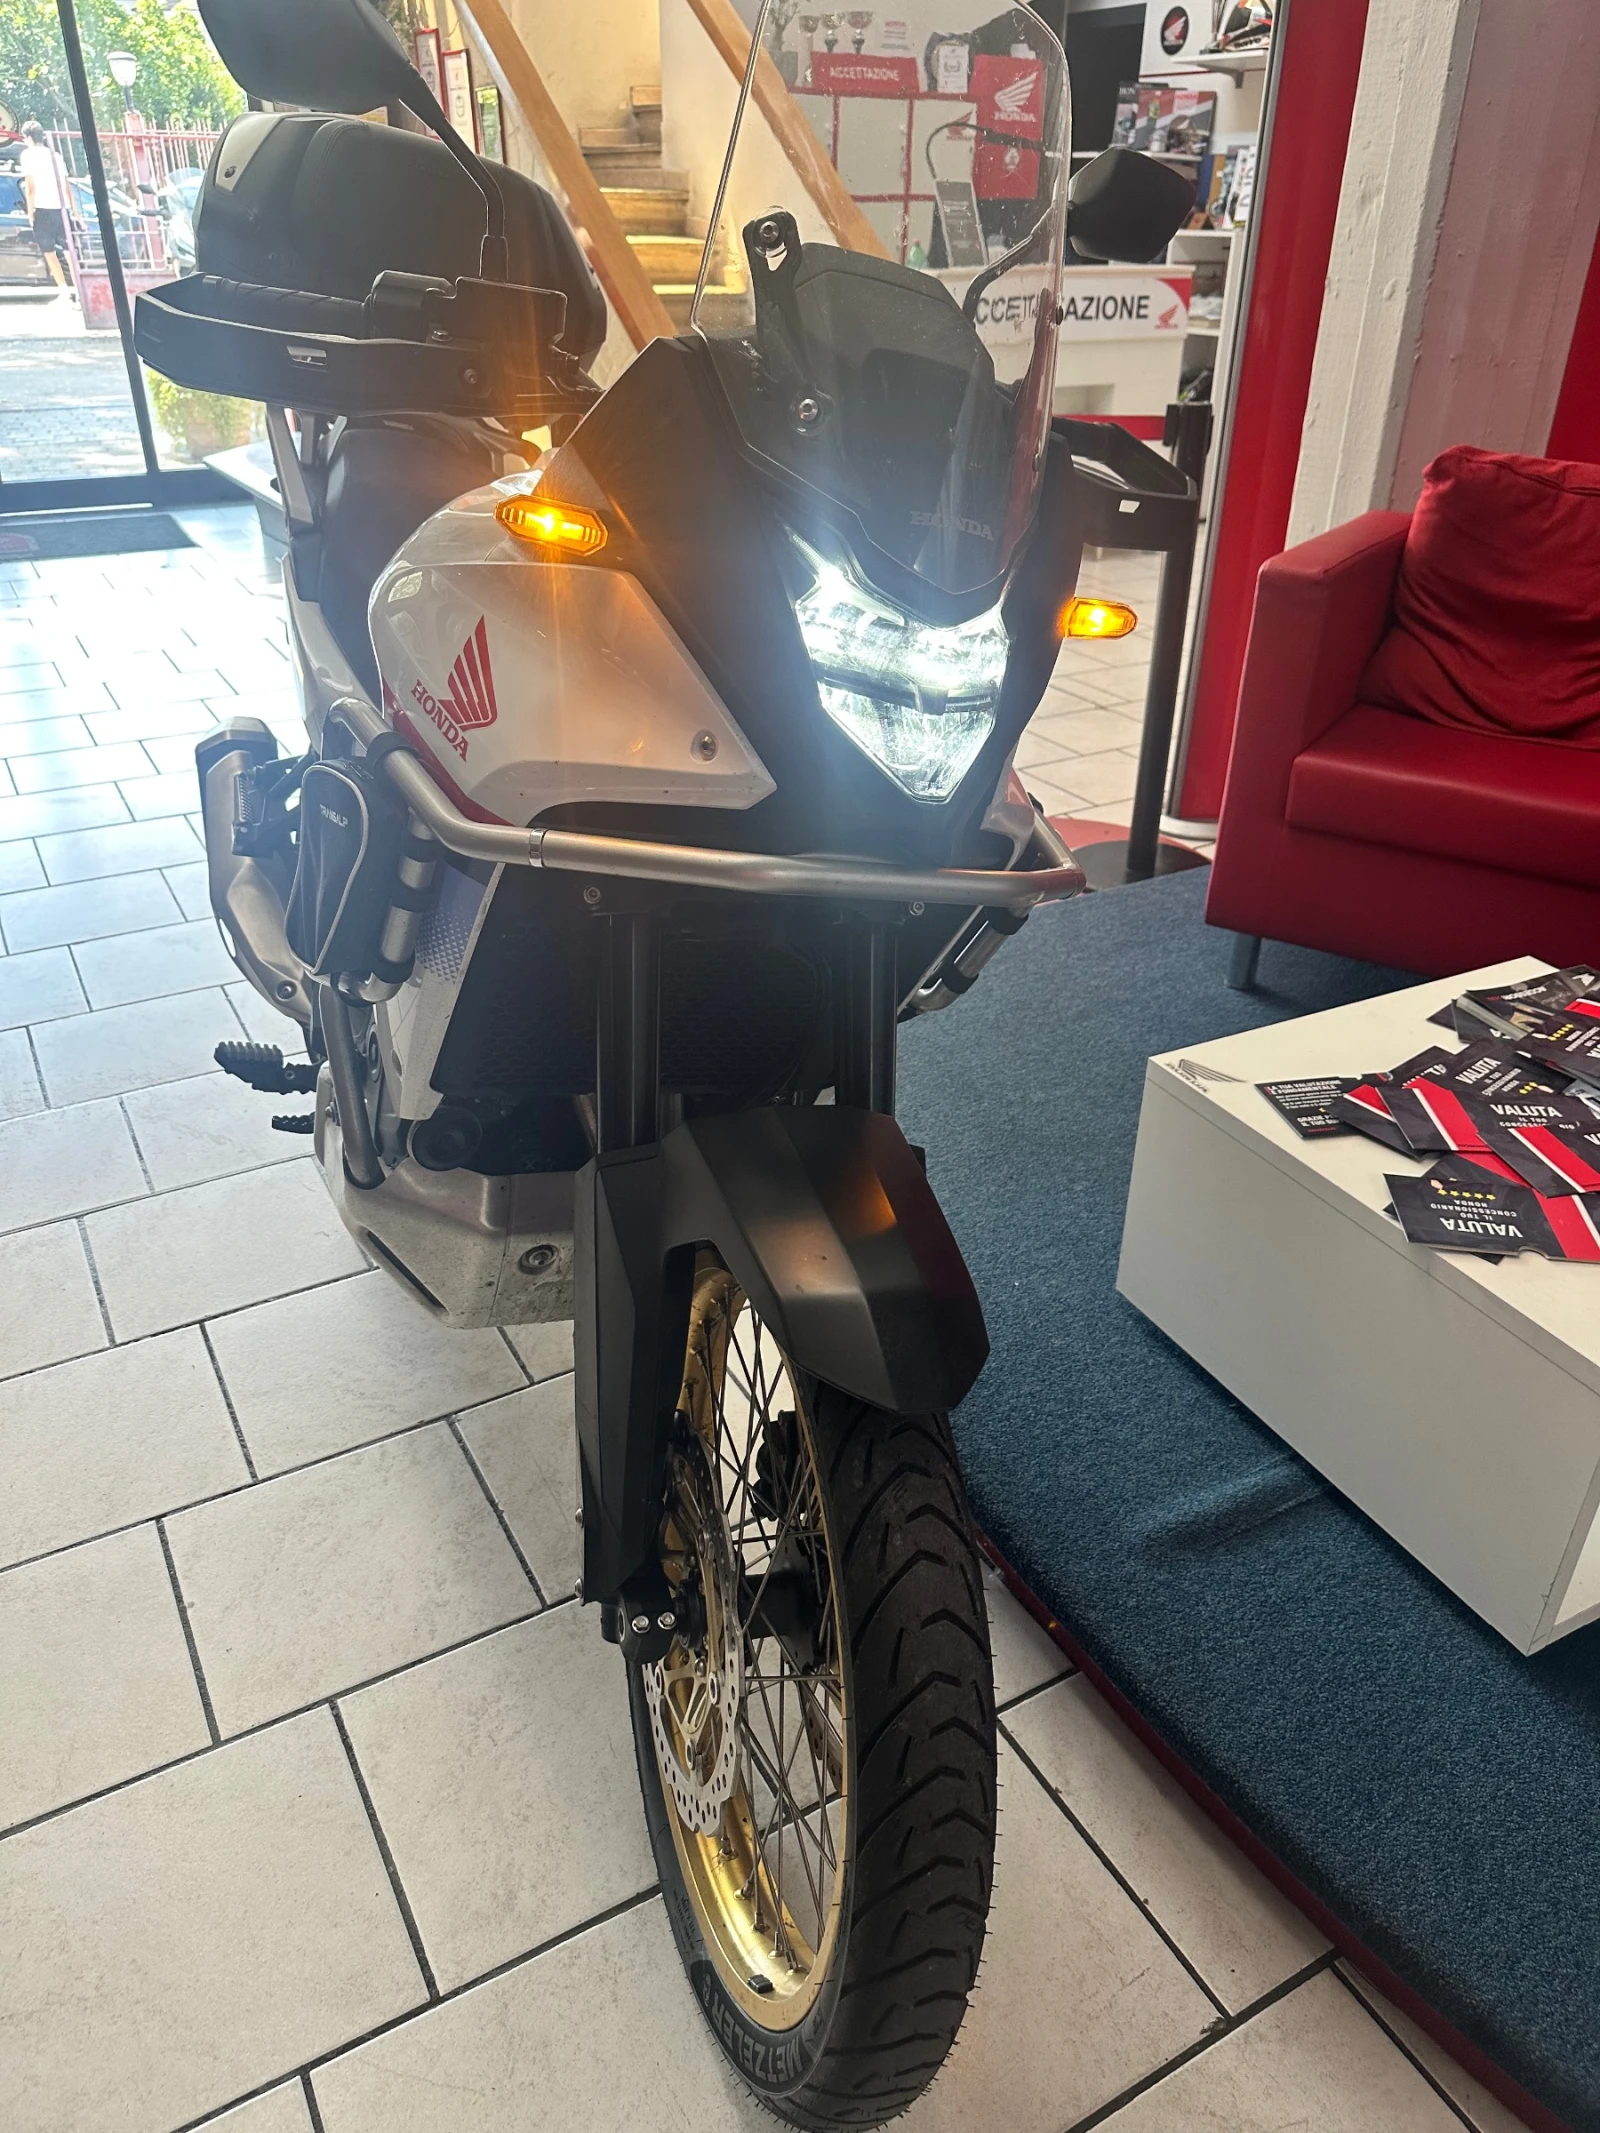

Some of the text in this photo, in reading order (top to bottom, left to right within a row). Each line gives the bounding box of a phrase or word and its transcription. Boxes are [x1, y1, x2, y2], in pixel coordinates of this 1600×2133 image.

[829, 66, 900, 81] ACCETTAZIONE
[994, 111, 1037, 123] HONDA
[410, 679, 469, 762] HONDA
[319, 803, 349, 828] TRANSALP
[1455, 1057, 1501, 1084] VALUTA
[1489, 1104, 1563, 1118] VALUTA
[1430, 1203, 1518, 1217] CONCESSIONARIO
[1453, 1199, 1488, 1208] HONDA
[1460, 1212, 1480, 1220] TUO
[1439, 1217, 1523, 1238] VALUTA
[711, 1991, 803, 2083] METZELER
